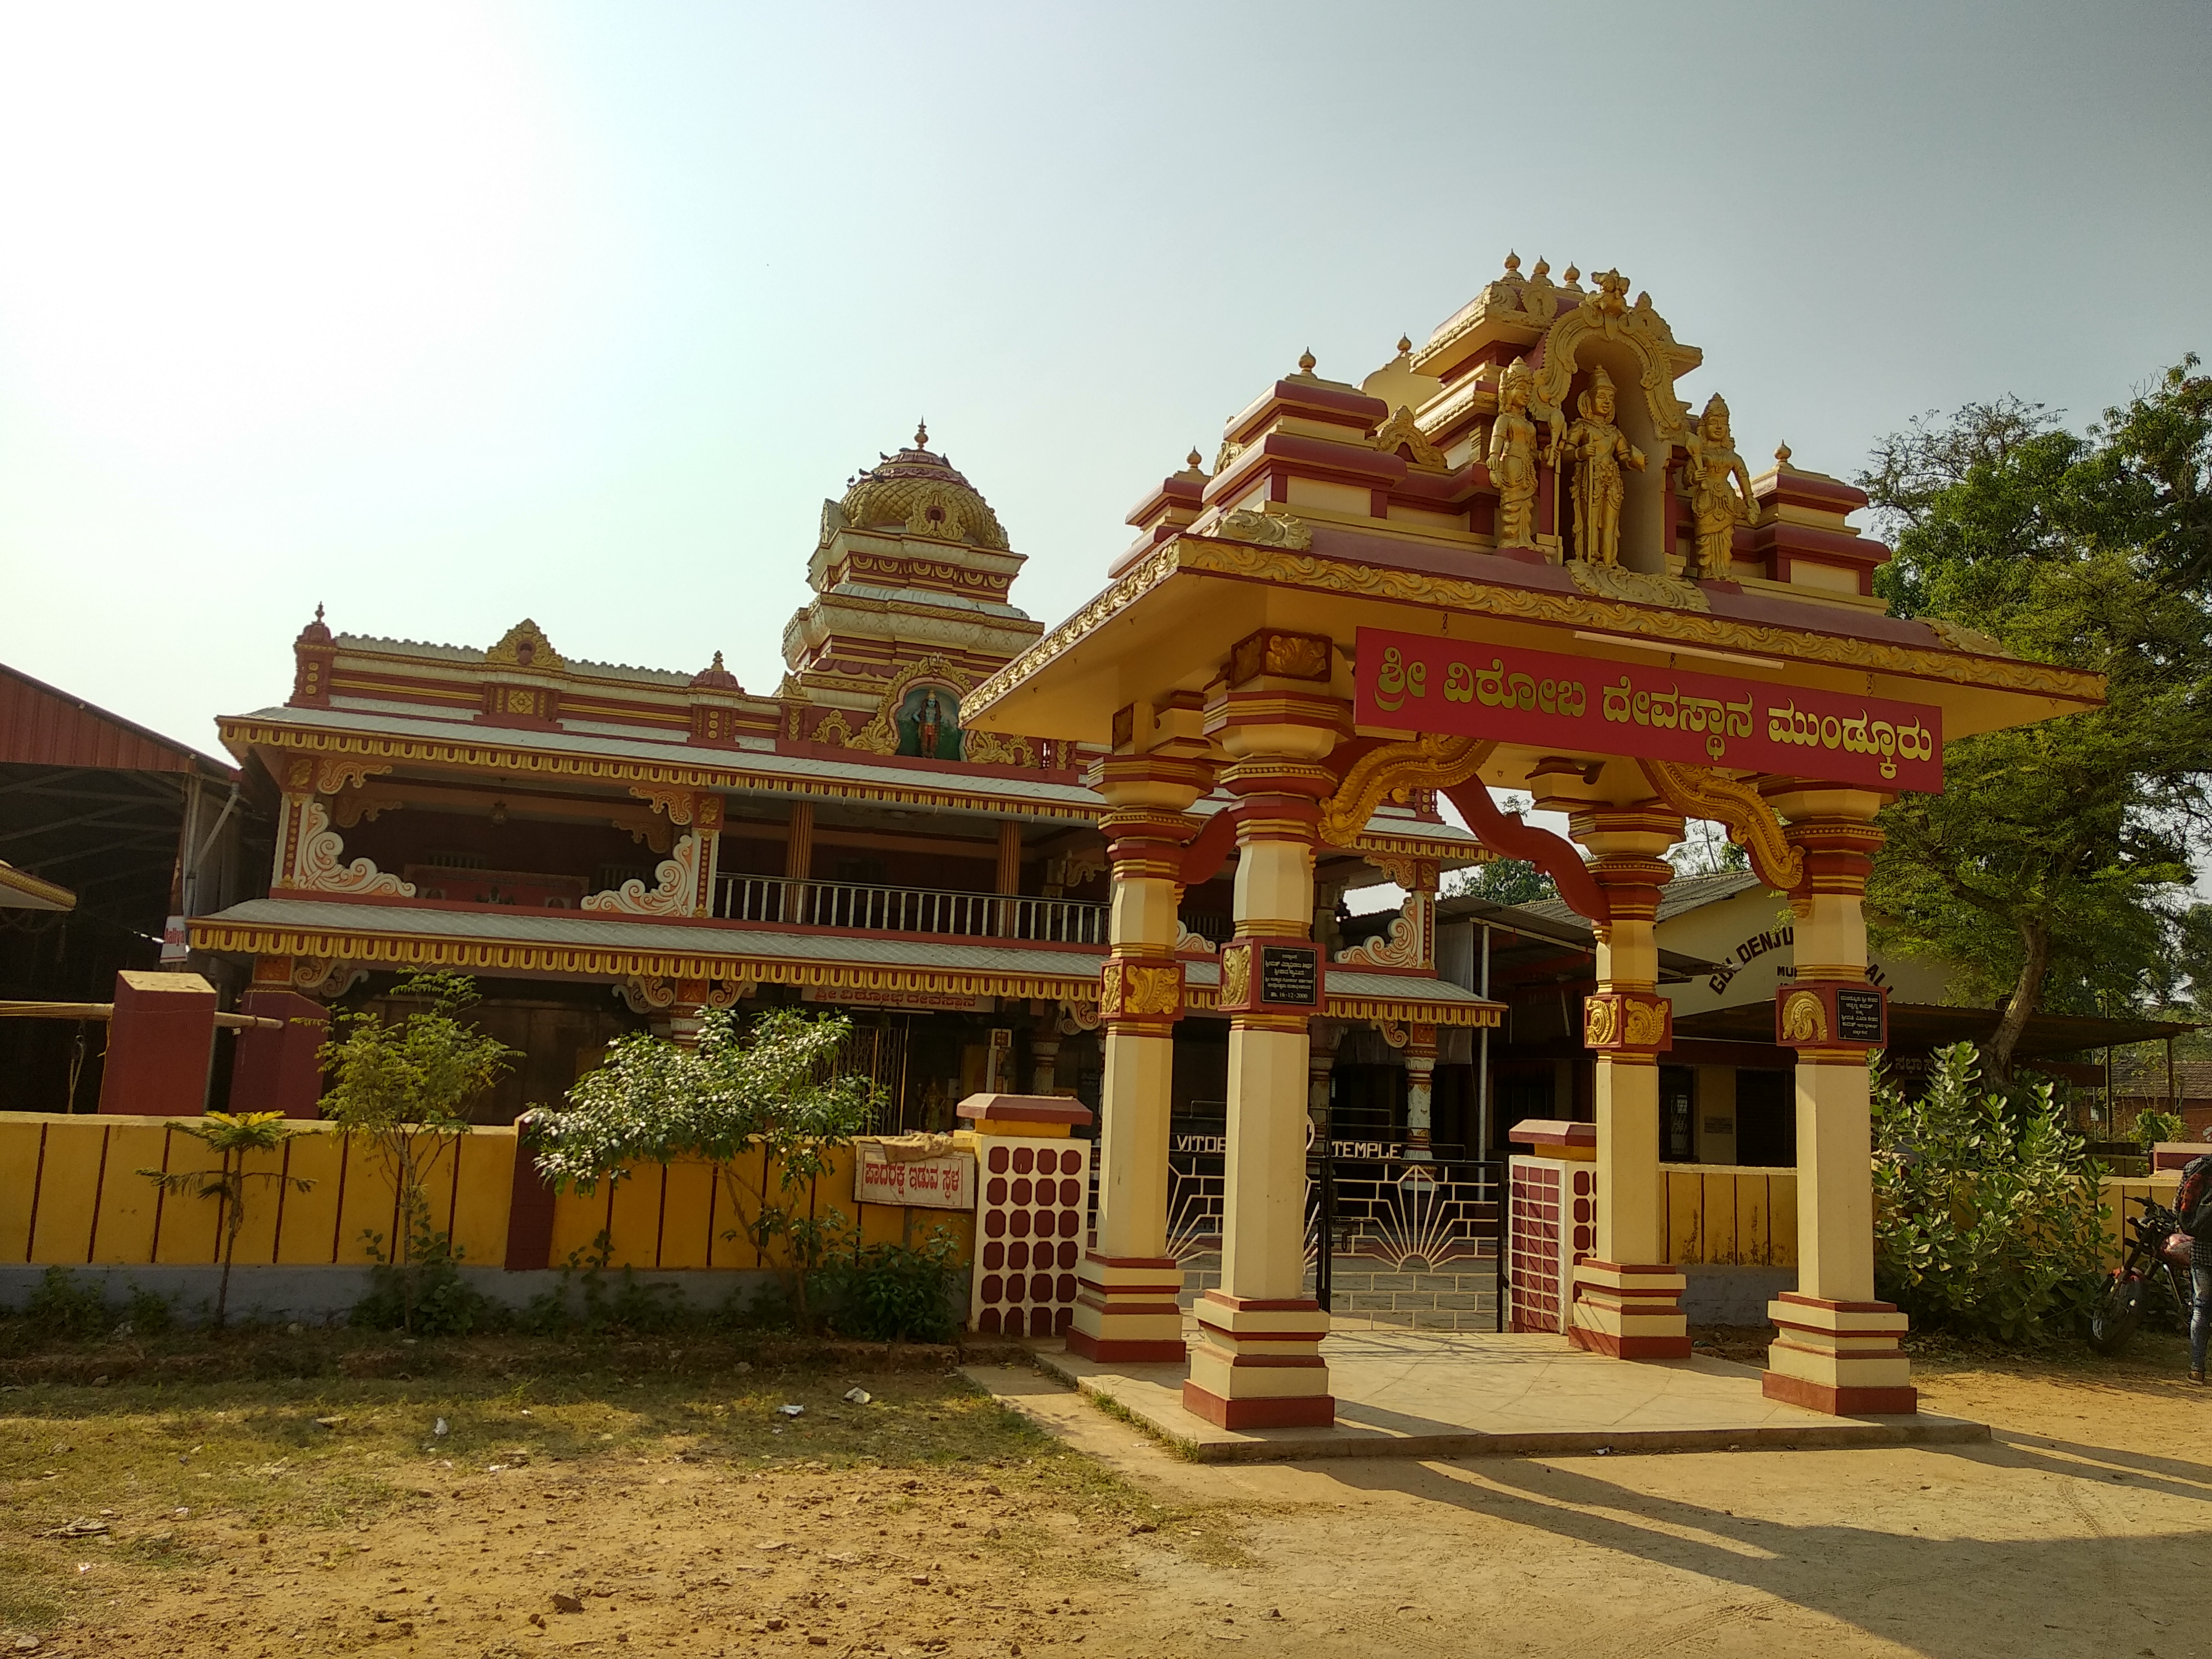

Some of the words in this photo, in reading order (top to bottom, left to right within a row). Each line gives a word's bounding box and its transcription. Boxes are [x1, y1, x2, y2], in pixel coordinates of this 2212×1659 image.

[1374, 647, 1426, 711] ಶ್ರೀ
[1443, 658, 1587, 717] ವಿಠೋಬ
[1603, 676, 1753, 761] ದೇವಸ್ಥಾನ
[1768, 698, 1932, 779] ಮುಂಡ್ಕೂರು
[815, 987, 836, 1001] ಶ್ರೀ
[1332, 1141, 1401, 1159] TEMPLE
[909, 1162, 938, 1190] ಇಡುವ
